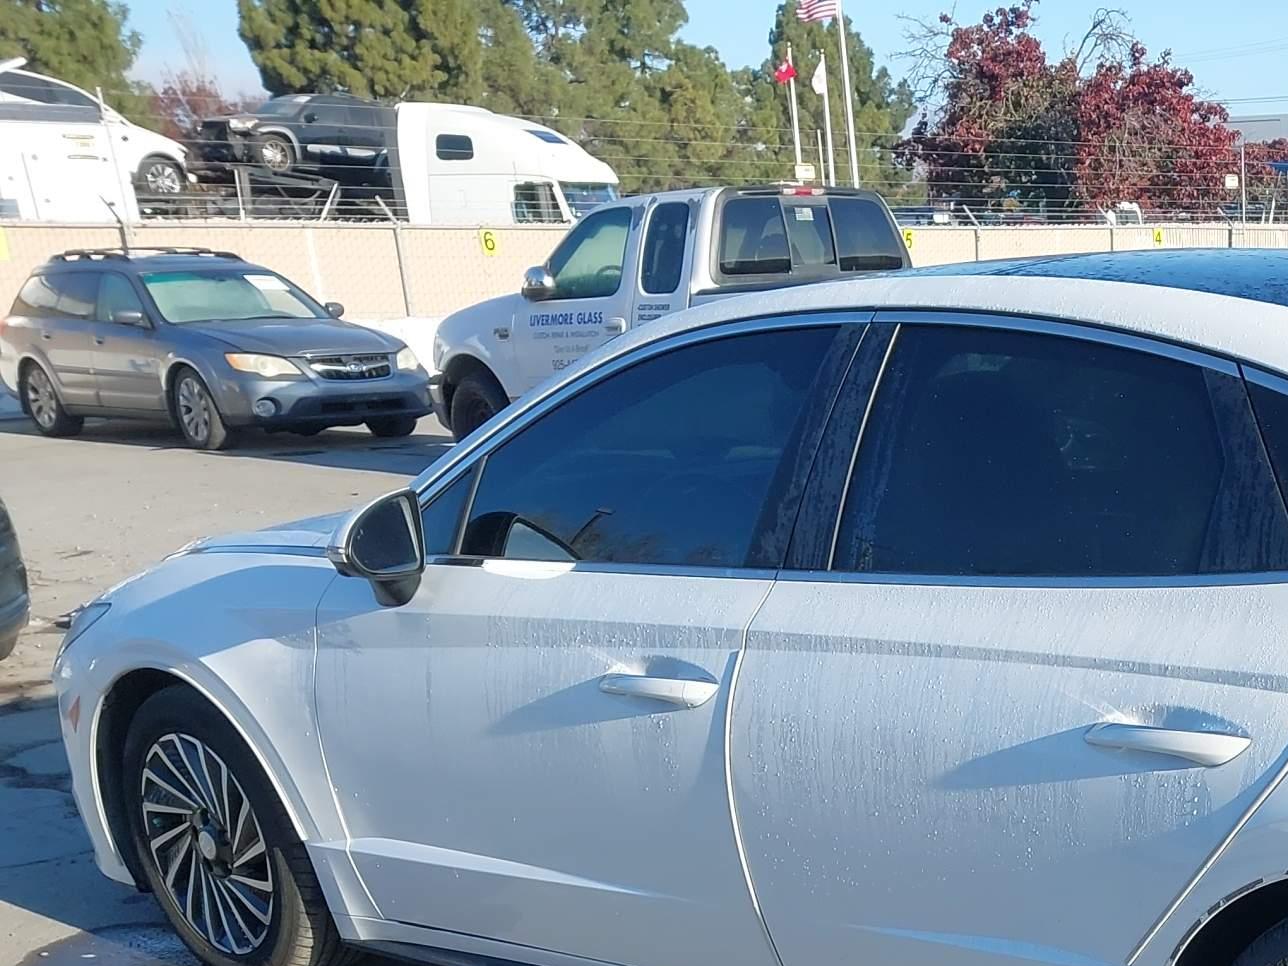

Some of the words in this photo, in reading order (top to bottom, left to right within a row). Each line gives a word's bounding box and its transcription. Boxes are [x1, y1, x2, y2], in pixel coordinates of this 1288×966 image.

[483, 231, 496, 251] 6
[905, 232, 913, 248] 5
[1155, 231, 1162, 246] 4
[529, 313, 574, 327] LIVERMORE
[576, 311, 603, 325] GLASS
